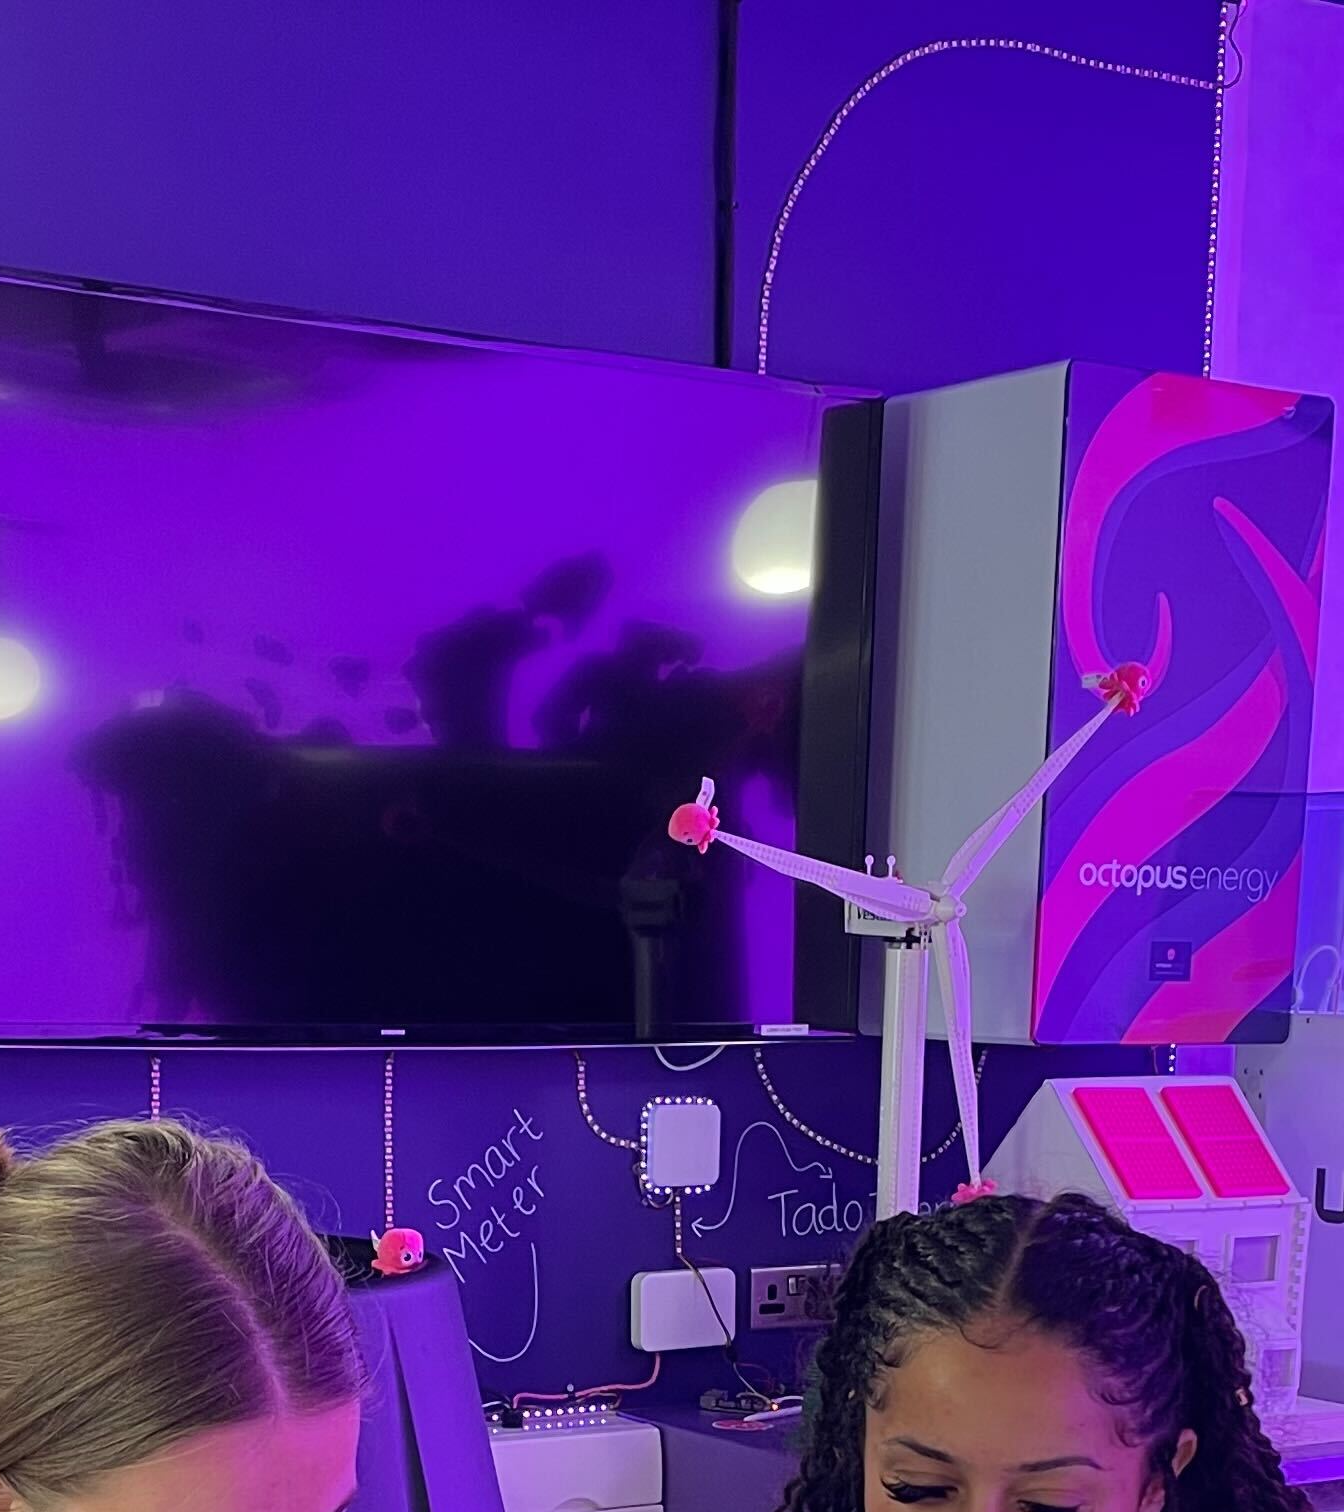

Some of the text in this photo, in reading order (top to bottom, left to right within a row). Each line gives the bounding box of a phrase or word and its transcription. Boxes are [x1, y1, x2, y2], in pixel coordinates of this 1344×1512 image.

[428, 1108, 544, 1229] Smart
[443, 1165, 544, 1283] Meter
[768, 1182, 863, 1237] Tado
